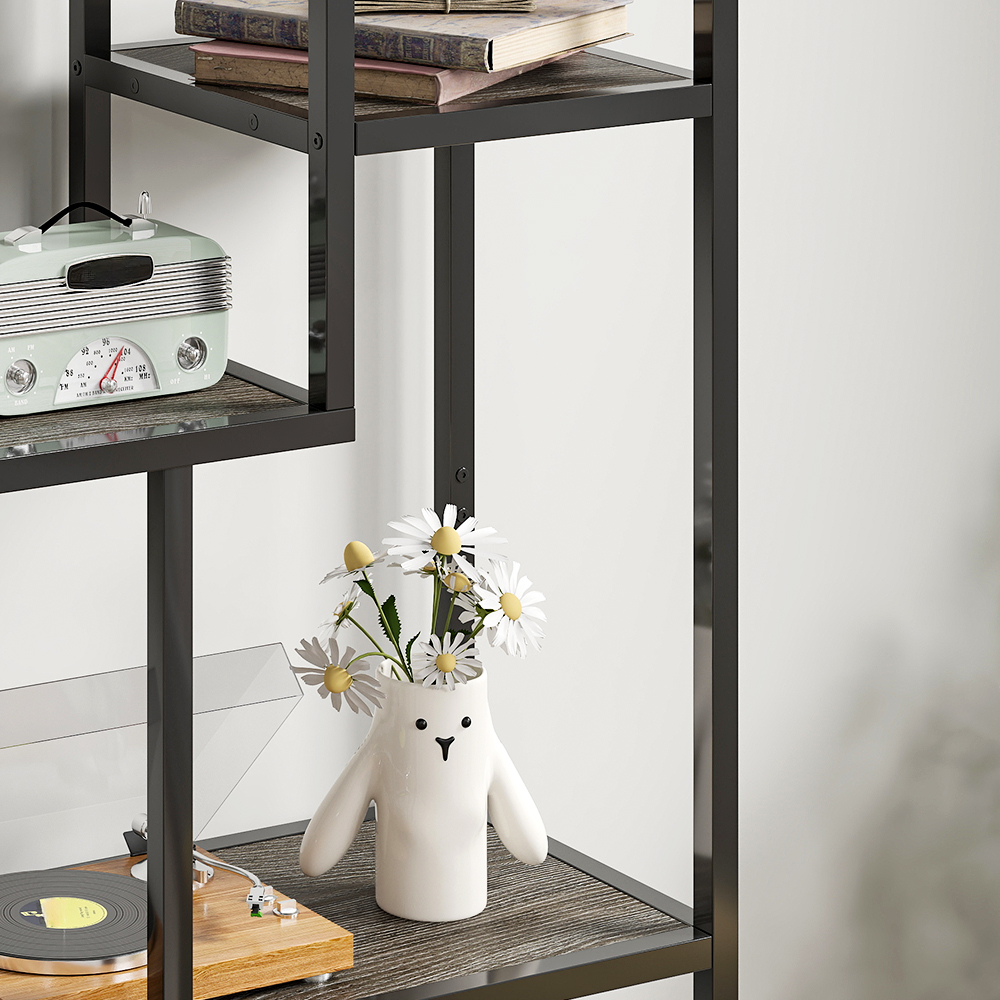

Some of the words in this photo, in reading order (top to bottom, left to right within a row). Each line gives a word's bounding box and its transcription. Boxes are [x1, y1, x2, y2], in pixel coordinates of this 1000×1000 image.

[101, 337, 110, 346] 96
[80, 346, 90, 356] 92
[135, 364, 146, 373] 108
[65, 369, 74, 377] 88
[139, 372, 151, 380] MHz
[60, 383, 69, 391] FM
